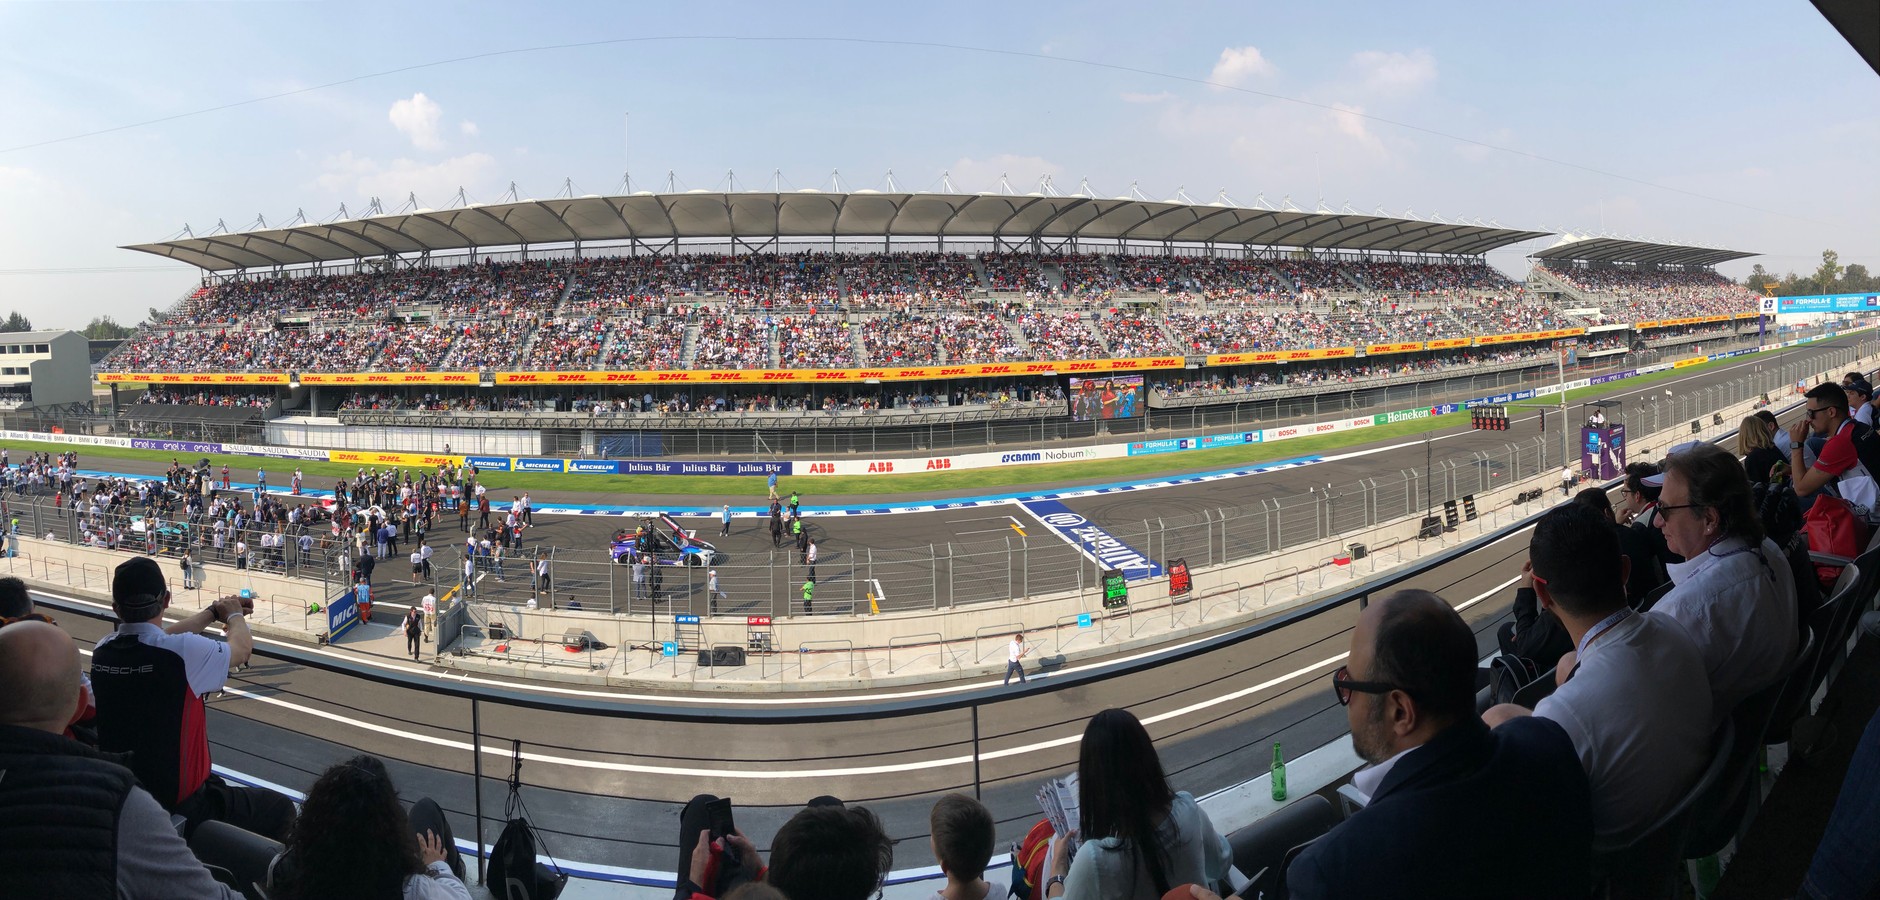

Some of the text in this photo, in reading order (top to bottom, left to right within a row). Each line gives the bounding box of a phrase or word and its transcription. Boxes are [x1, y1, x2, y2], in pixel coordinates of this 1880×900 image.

[557, 374, 587, 382] DHL
[657, 373, 690, 381] DHL
[763, 372, 796, 380] DHL
[815, 372, 848, 380] DHL
[940, 368, 967, 376] DHL
[979, 366, 1011, 374] DHL
[1025, 364, 1055, 372] DHL
[1068, 363, 1097, 371] DHL
[1110, 361, 1139, 369] DHL
[1150, 359, 1177, 367] DHL
[1387, 408, 1429, 423] Heineken
[1278, 429, 1297, 437] BOSCH
[1316, 424, 1335, 432] BOSCH
[134, 440, 149, 448] enel
[163, 442, 179, 450] enel
[193, 444, 211, 452] enel
[228, 444, 327, 457] SAUDIA SAUDIA SAUDIA
[1011, 452, 1041, 462] CBMM
[1045, 450, 1084, 460] Niobium
[628, 463, 782, 473] Julius Bär Julius Bär Julius Bär
[809, 458, 951, 474] ABB ABB ABB
[1070, 525, 1157, 572] Allianz
